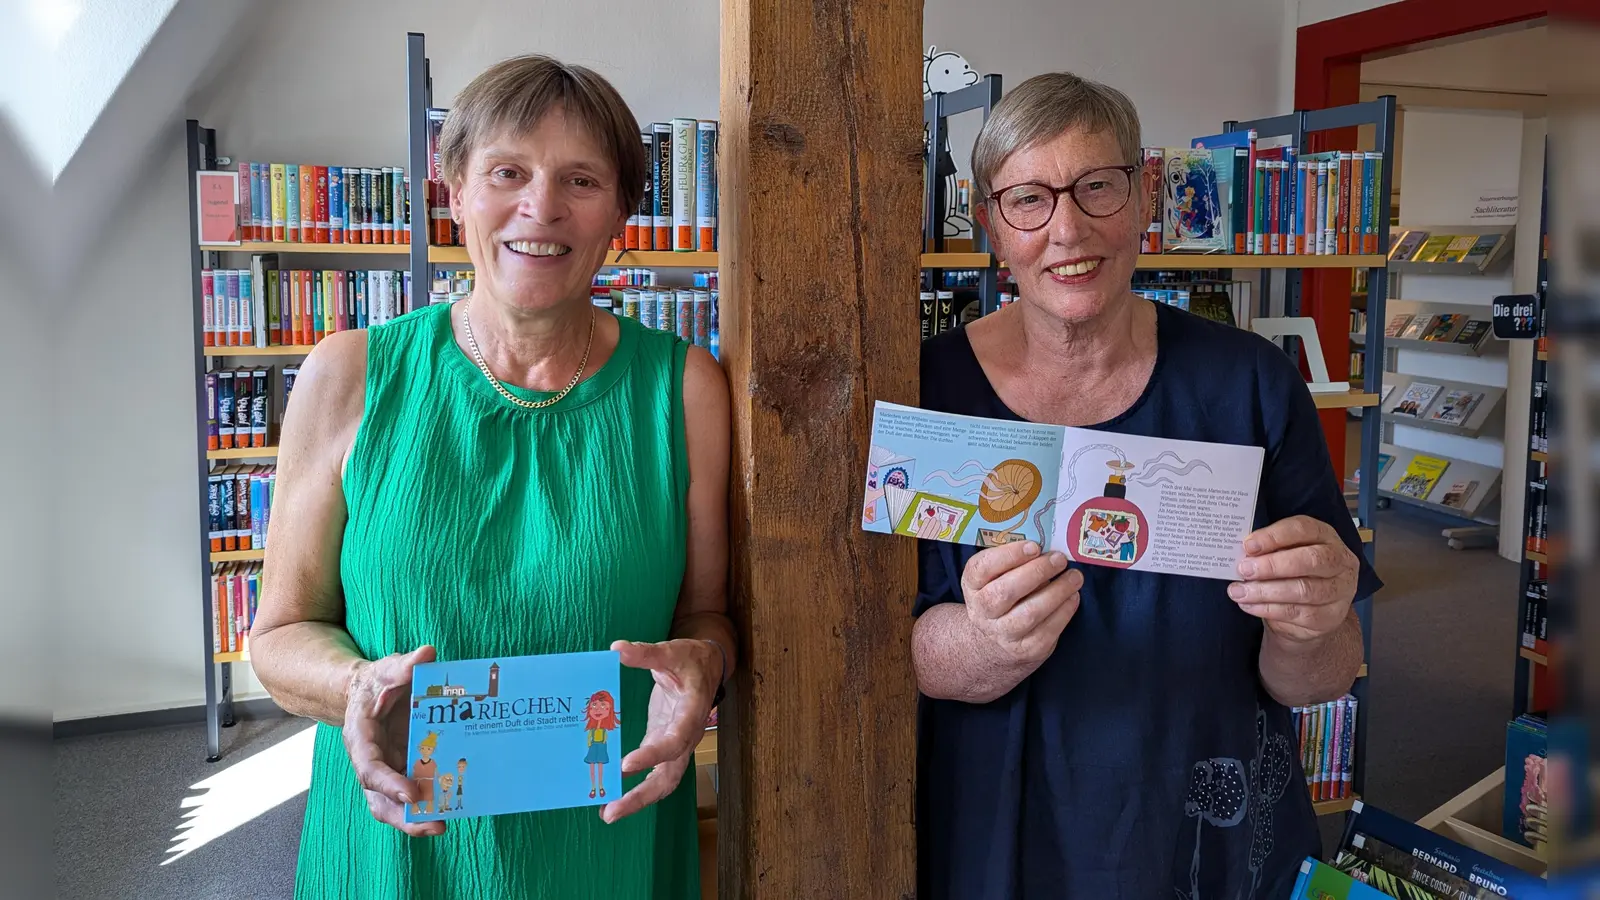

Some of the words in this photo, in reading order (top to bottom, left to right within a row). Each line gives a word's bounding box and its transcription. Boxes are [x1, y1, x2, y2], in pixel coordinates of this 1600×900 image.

[1474, 205, 1518, 214] Sachliteratur
[1493, 303, 1510, 316] Die
[1512, 302, 1533, 316] drei
[1513, 316, 1534, 331] ???
[412, 712, 426, 720] Wie
[465, 723, 477, 731] mit
[480, 722, 502, 730] einem
[505, 719, 521, 727] Duft
[537, 717, 556, 725] Stadt
[559, 715, 578, 723] rettet
[1412, 848, 1457, 874] BERNARD
[1469, 873, 1507, 896] BRUNO
[1411, 869, 1430, 886] BRICE
[1430, 876, 1451, 895] COSSU
